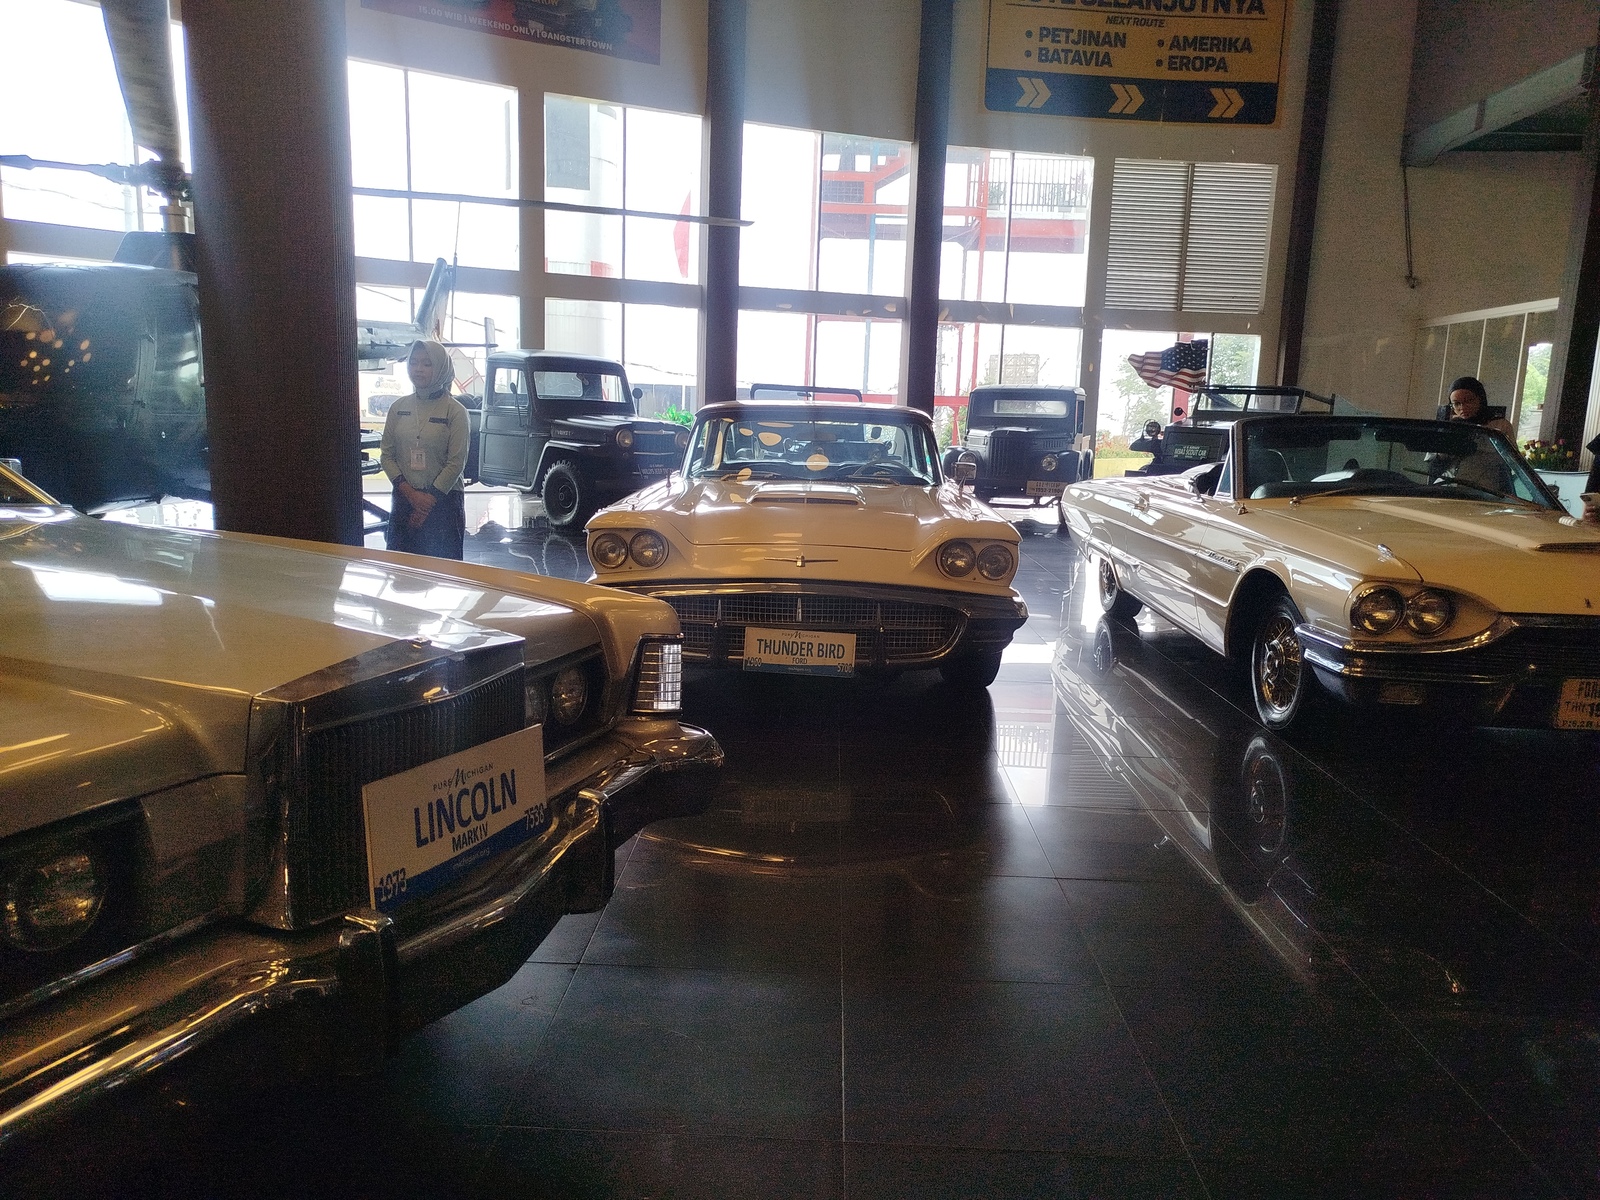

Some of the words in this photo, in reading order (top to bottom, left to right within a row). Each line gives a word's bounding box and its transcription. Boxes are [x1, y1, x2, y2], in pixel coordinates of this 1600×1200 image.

[444, 11, 462, 21] WIB
[468, 16, 511, 31] WEEKEND
[512, 25, 537, 36] ONLY
[541, 31, 585, 46] GANGSTER
[586, 39, 613, 51] TOWN
[1105, 15, 1132, 25] NEXT
[1133, 17, 1166, 28] ROUTE
[1038, 26, 1127, 48] PETJINAN
[1168, 36, 1254, 54] AMERIKA
[1037, 47, 1113, 68] BATAVIA
[1167, 55, 1229, 73] EROPA
[757, 639, 814, 657] THUNDER
[817, 643, 845, 659] BIRD
[1578, 681, 1600, 699] FOR
[414, 769, 517, 848] LINCOLN
[380, 867, 407, 902] 1973
